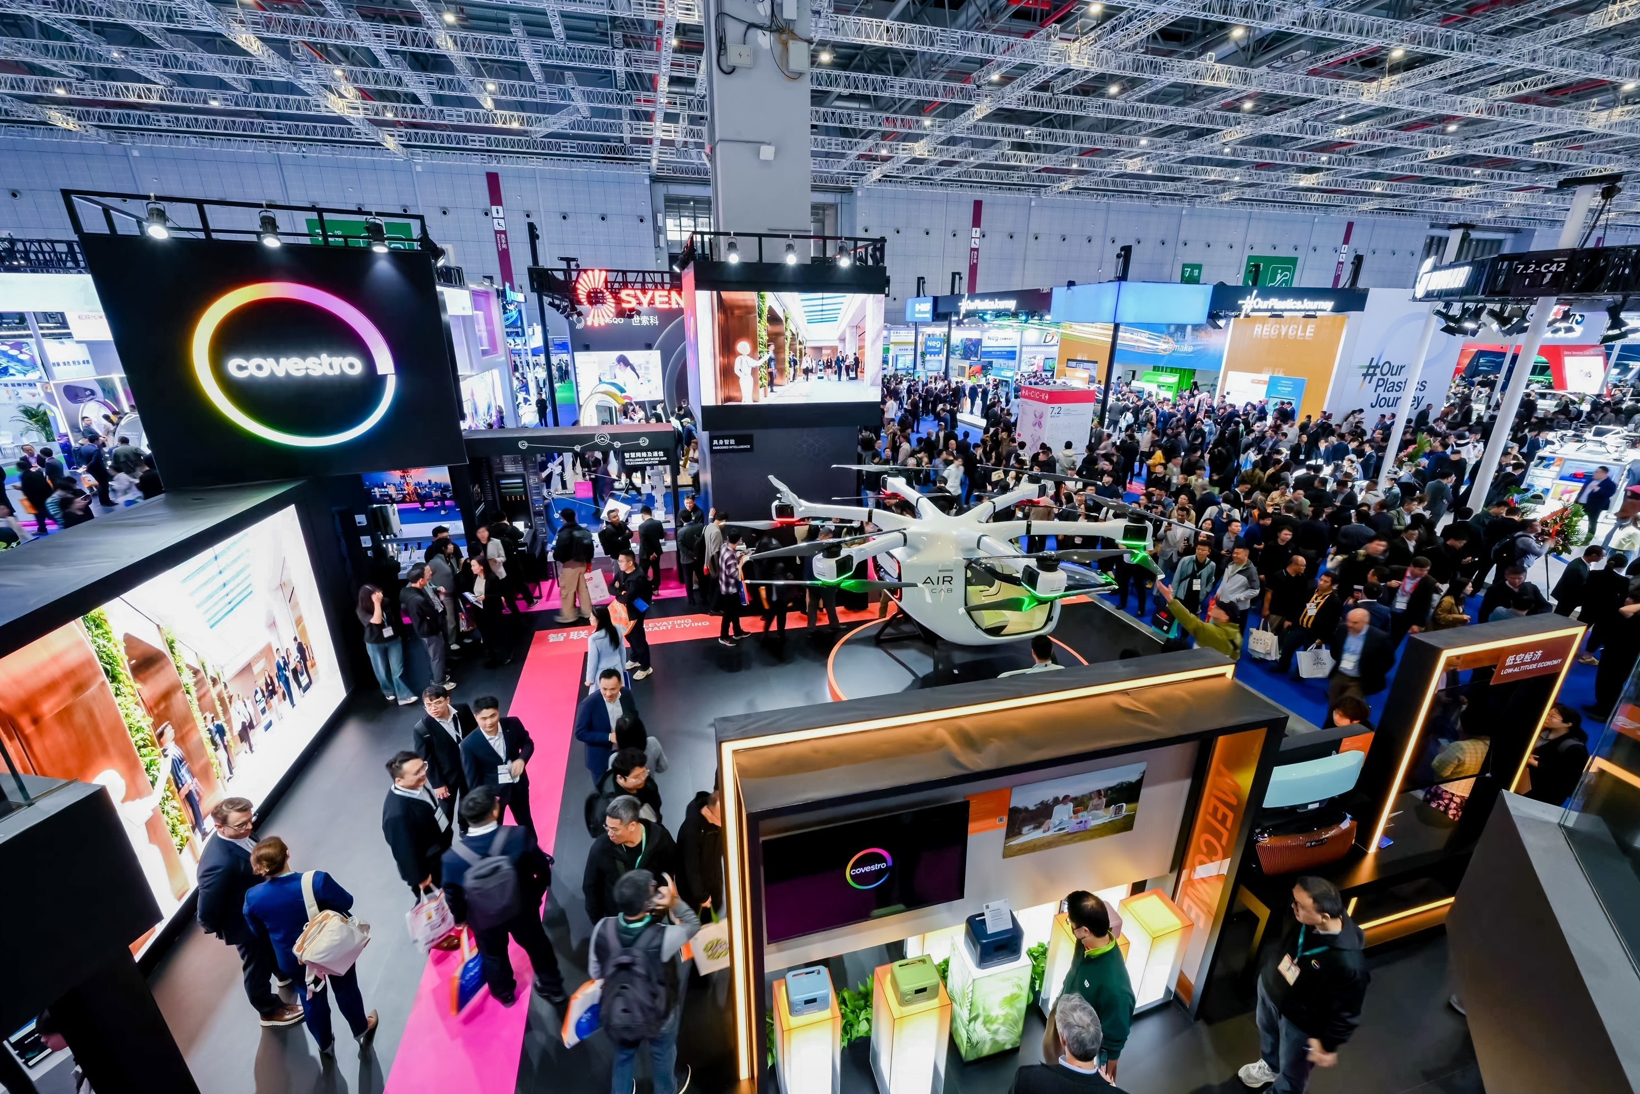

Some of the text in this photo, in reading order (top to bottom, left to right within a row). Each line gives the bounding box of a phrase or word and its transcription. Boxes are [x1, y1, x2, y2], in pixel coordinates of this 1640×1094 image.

[1516, 262, 1567, 274] 7.2-C42
[1237, 289, 1335, 320] #OurPlasticsJourney
[631, 315, 660, 326] 世索科
[1253, 324, 1316, 340] RECYCLE
[227, 353, 363, 378] covestro
[1360, 357, 1407, 384] #Our
[1373, 377, 1428, 393] Plasts
[1370, 393, 1425, 410] Jourey
[1049, 406, 1062, 415] 7.2
[922, 575, 954, 586] AIR
[643, 618, 693, 628] LEVATING
[675, 620, 710, 629] LIVING
[1505, 649, 1543, 667] 低空经济
[1500, 658, 1563, 675] LOW-ALTITUDE ECONOMY
[850, 862, 887, 875] covestro
